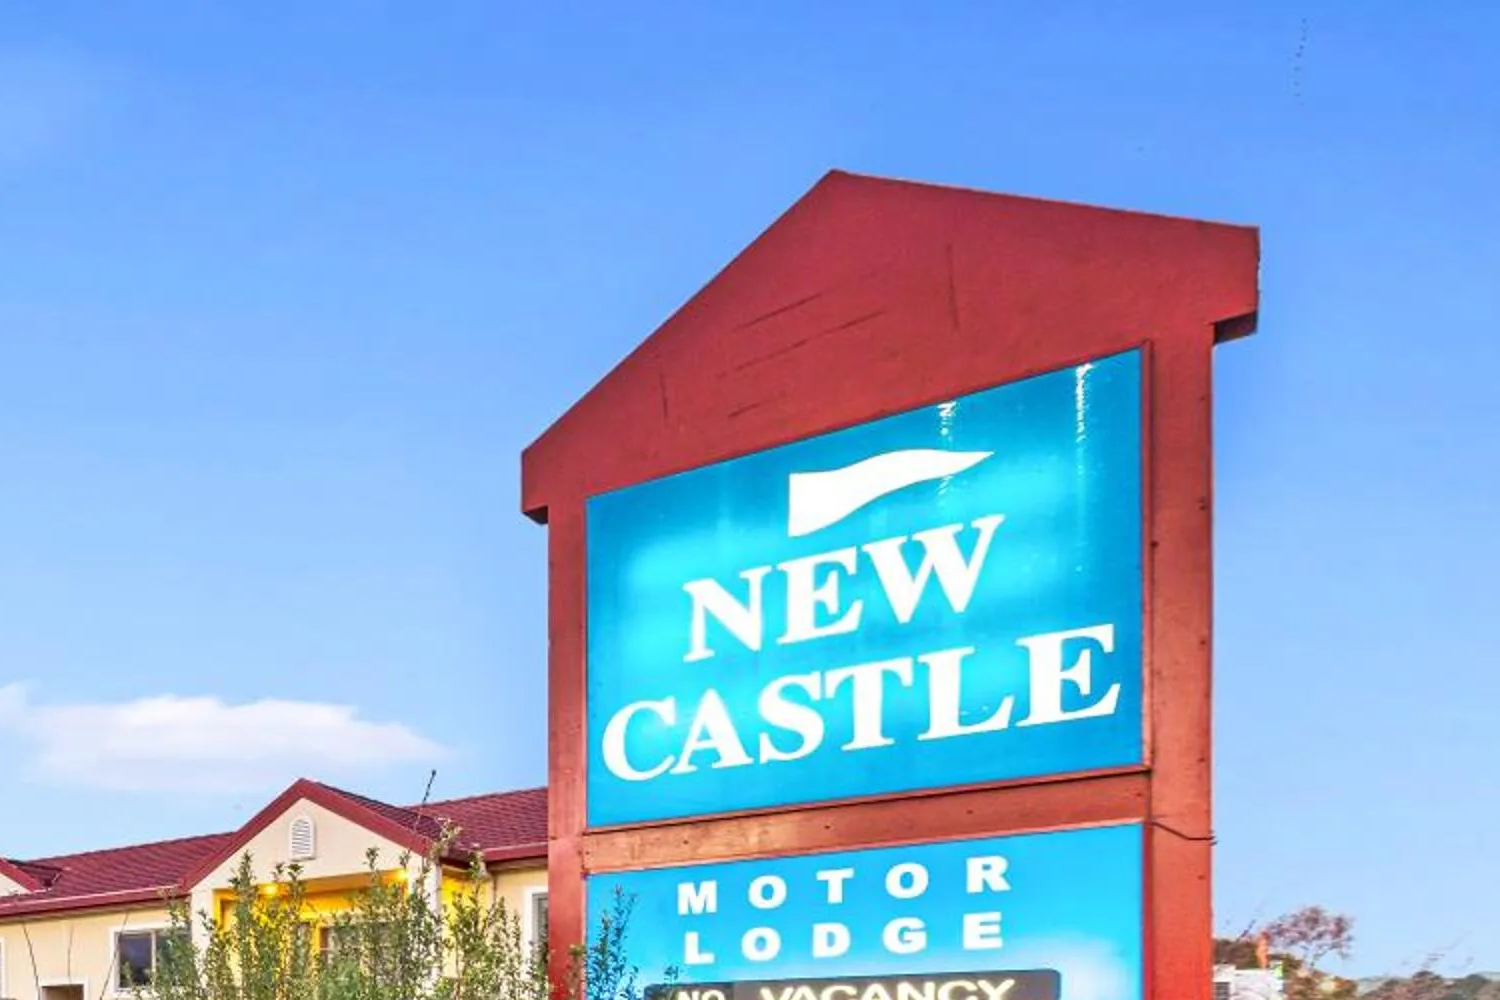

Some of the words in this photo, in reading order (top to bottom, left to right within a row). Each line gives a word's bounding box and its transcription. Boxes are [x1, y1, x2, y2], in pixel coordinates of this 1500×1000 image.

[683, 514, 1004, 662] NEW
[602, 623, 1120, 781] CASTLE
[677, 855, 1011, 915] MOTOR
[683, 912, 1003, 964] LODGE
